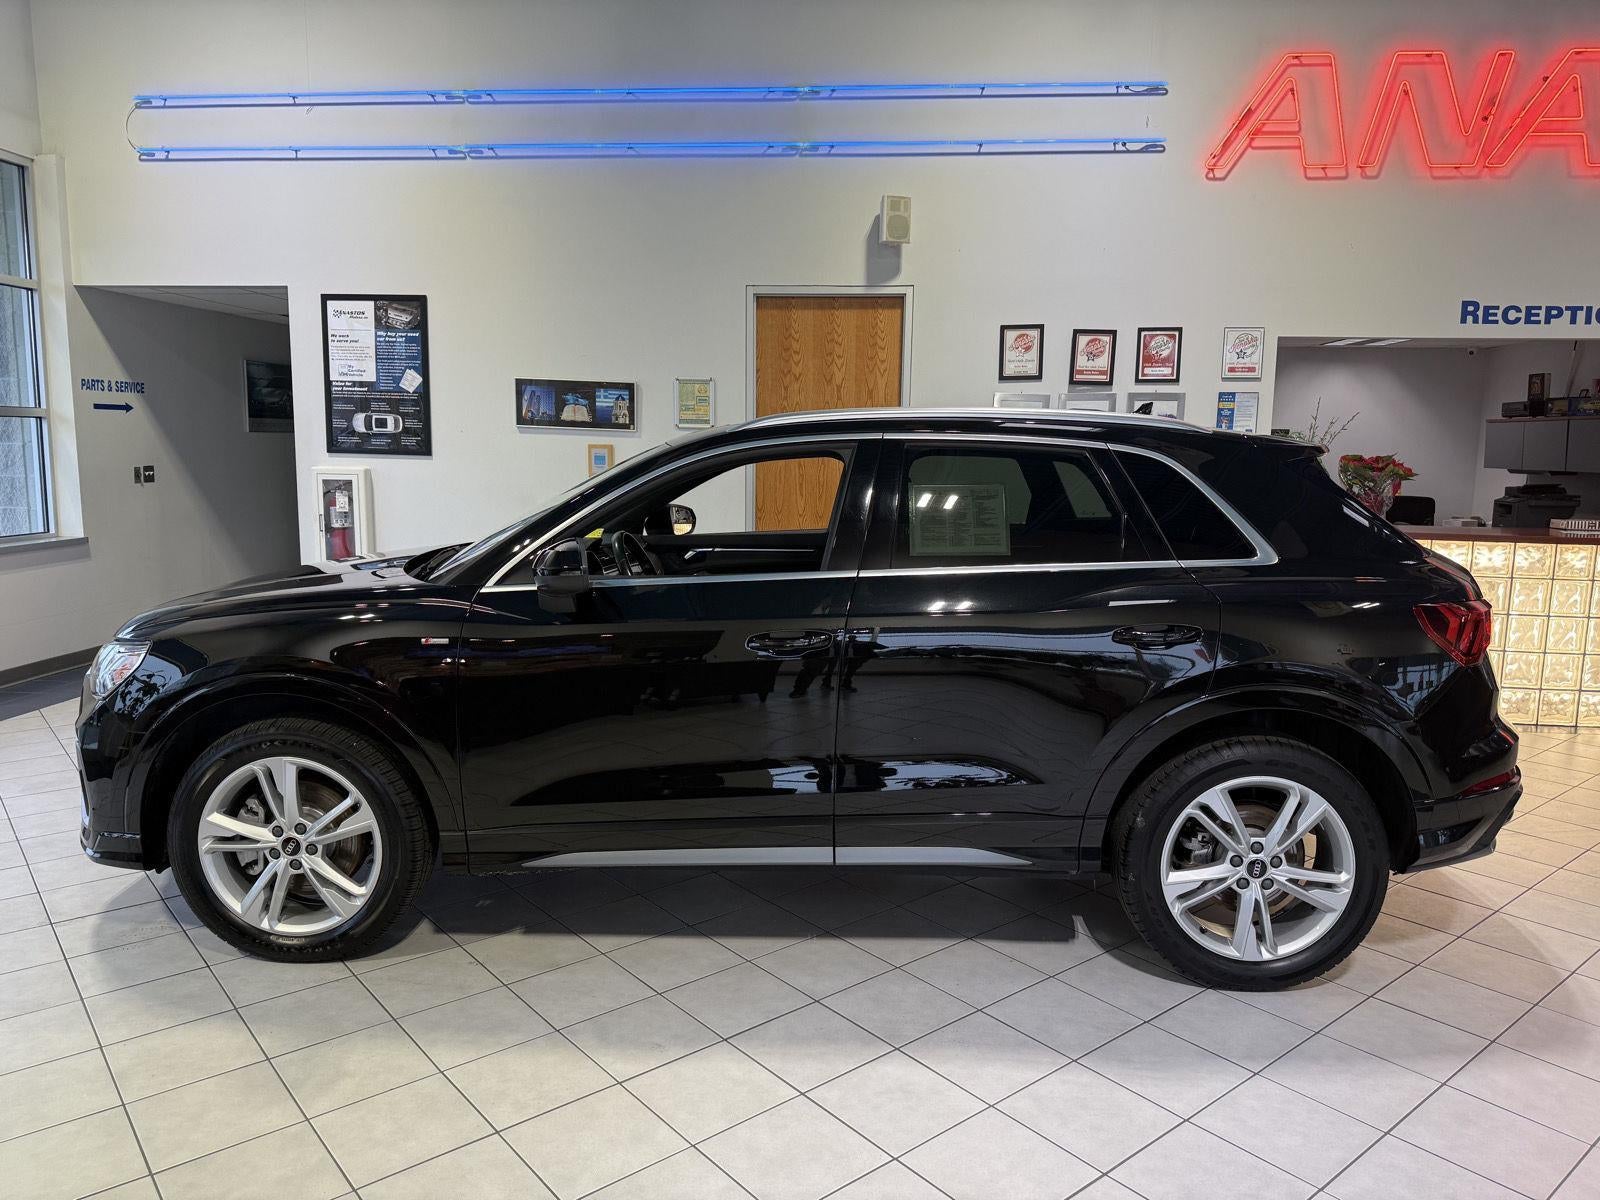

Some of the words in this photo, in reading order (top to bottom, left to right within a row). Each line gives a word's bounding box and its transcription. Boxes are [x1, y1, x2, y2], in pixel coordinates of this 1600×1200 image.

[1205, 48, 1600, 168] ANA
[1460, 300, 1600, 325] RECEPTI
[80, 378, 105, 392] PARTS
[107, 380, 113, 392] &
[115, 381, 145, 394] SERVICE
